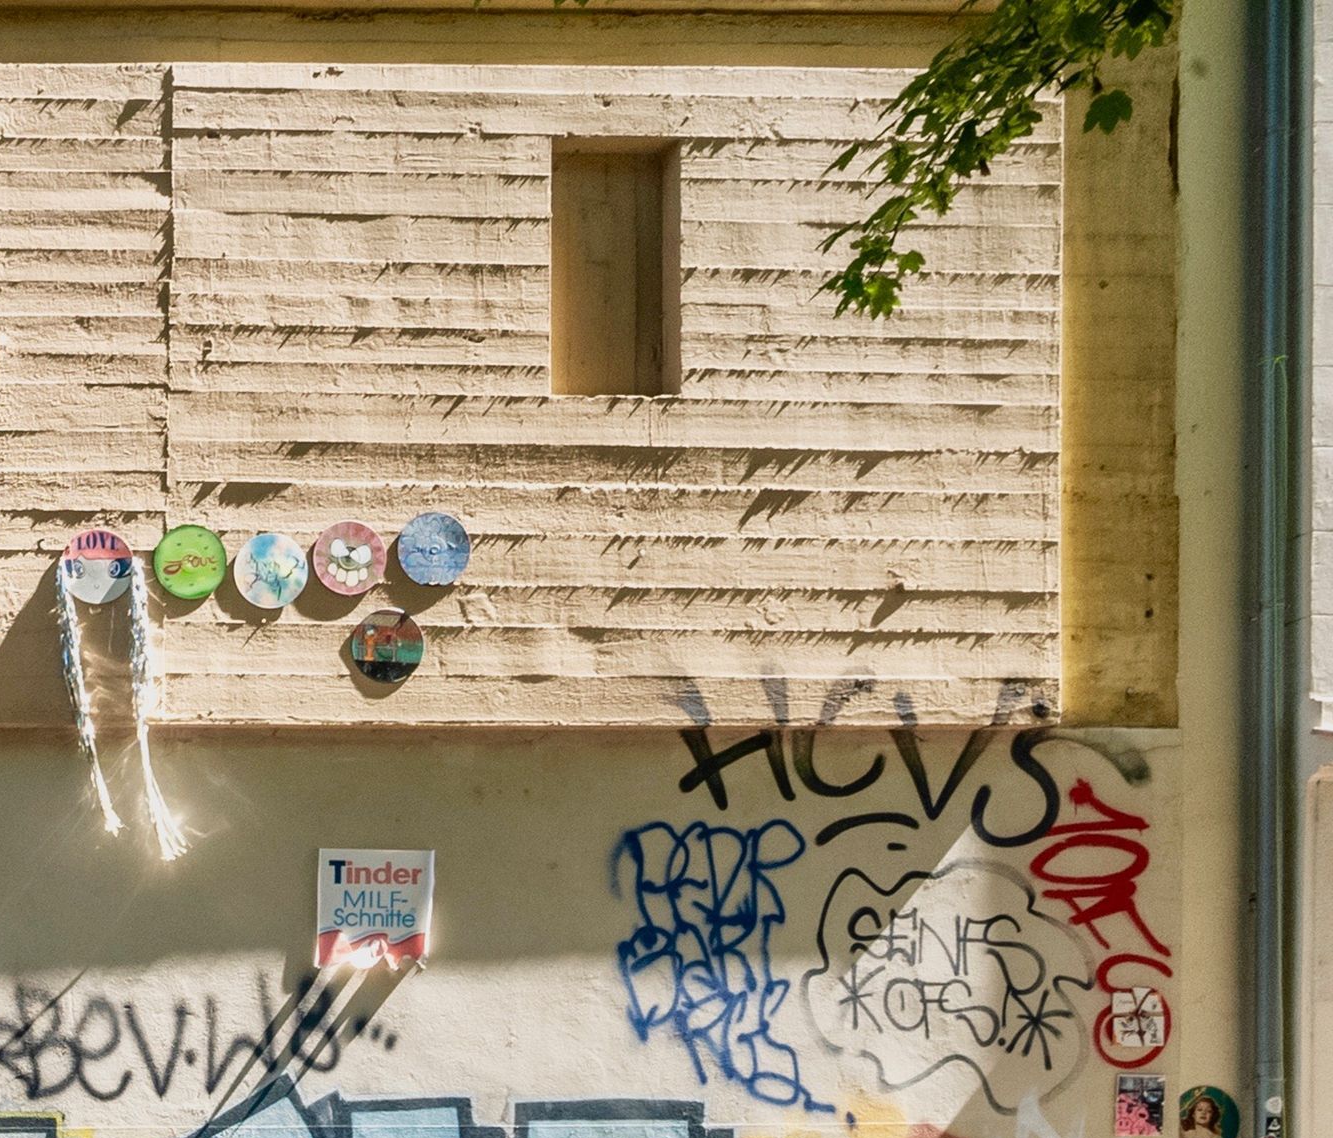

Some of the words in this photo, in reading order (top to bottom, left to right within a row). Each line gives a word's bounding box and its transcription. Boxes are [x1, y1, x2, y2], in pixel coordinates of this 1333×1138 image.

[76, 531, 119, 551] LOVE
[328, 860, 422, 885] Tinder
[343, 890, 409, 909] MILF-
[333, 908, 416, 928] Schnitte
